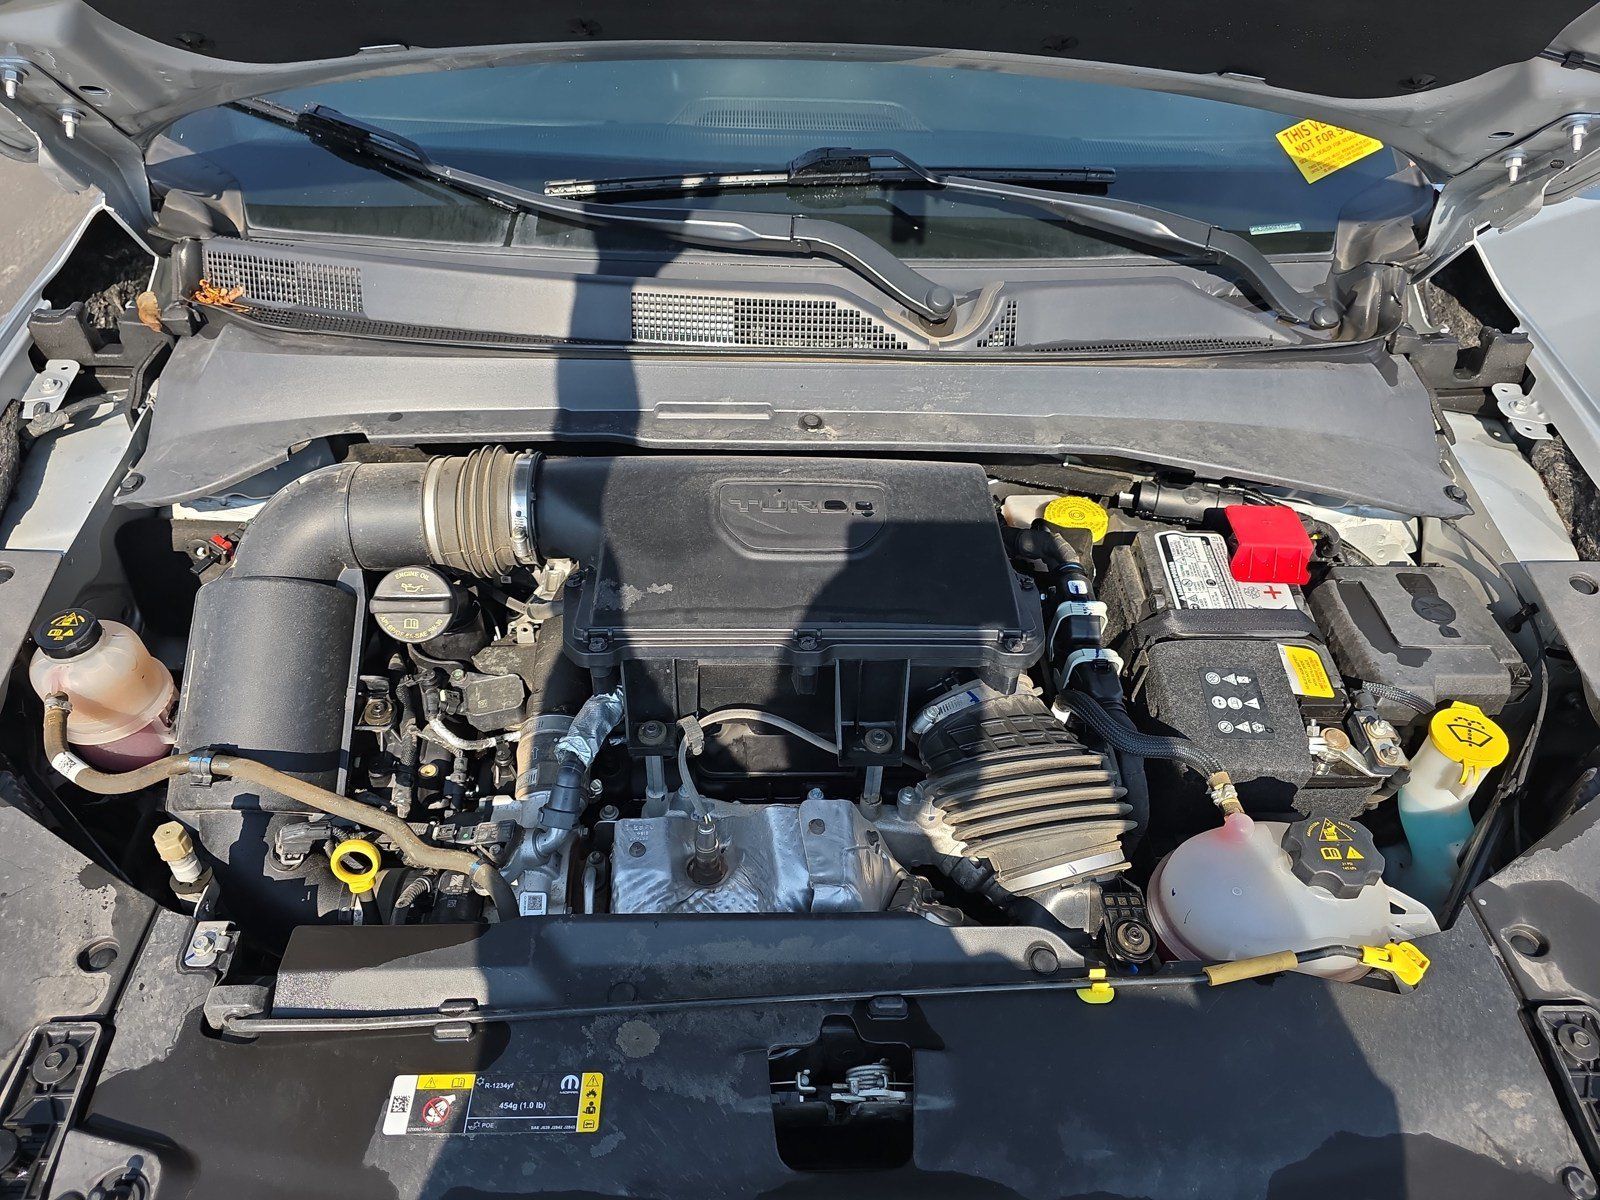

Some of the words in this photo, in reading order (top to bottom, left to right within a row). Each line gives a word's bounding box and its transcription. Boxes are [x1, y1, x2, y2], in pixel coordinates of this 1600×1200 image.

[1283, 124, 1311, 144] THIS
[1295, 139, 1315, 155] NOT
[1316, 130, 1336, 145] FOR
[394, 571, 419, 580] ENGINE
[419, 573, 430, 581] OIL
[484, 1081, 515, 1090] R-1234yf
[499, 1101, 518, 1111] 454g
[519, 1101, 536, 1110] (1.0
[536, 1101, 547, 1110] lb)
